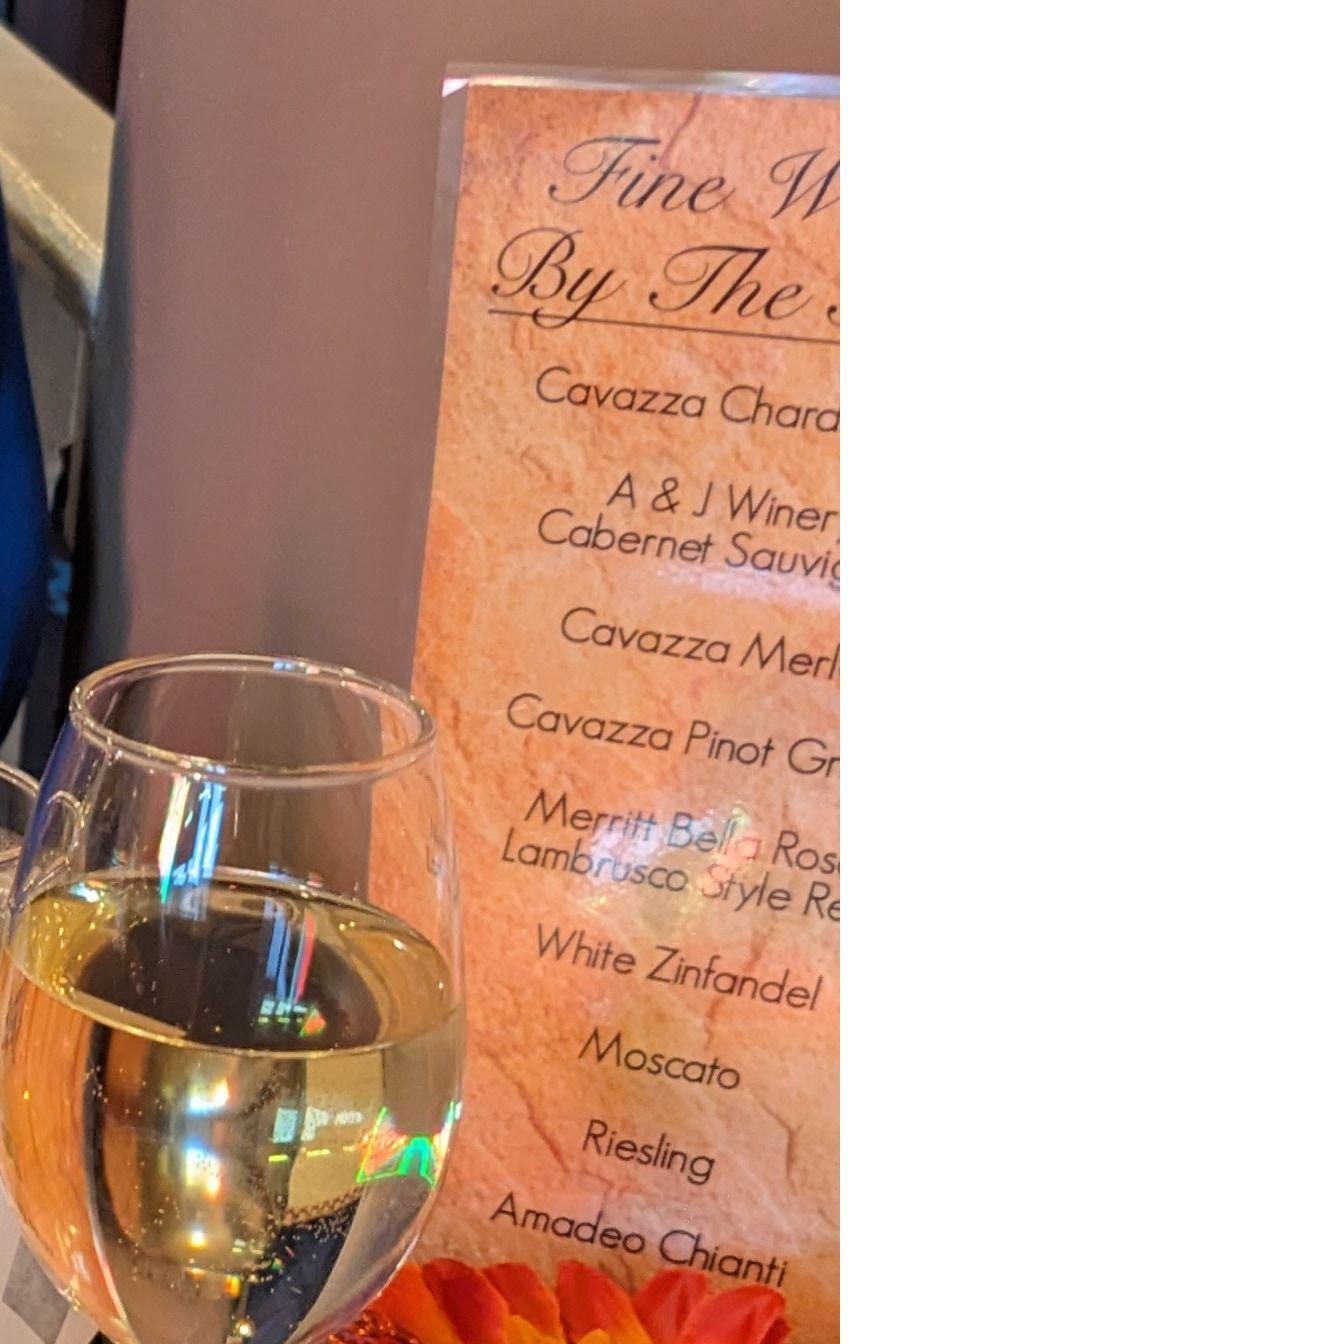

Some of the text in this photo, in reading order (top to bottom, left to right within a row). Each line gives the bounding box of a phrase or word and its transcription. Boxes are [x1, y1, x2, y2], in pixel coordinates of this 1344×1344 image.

[549, 136, 734, 208] Fine
[491, 227, 814, 329] By The
[536, 366, 707, 419] Cavazza
[538, 508, 713, 563] Cabernet
[606, 473, 840, 544] A & J Winer
[561, 606, 840, 680] Cavazza Merl
[507, 692, 674, 751] Cavazza
[685, 719, 775, 767] Pinot
[524, 788, 657, 842] Merritt
[772, 829, 840, 875] Ros
[502, 828, 689, 892] Lambrusco
[700, 862, 792, 912] Style
[537, 922, 824, 1011] White Zinfandel
[579, 1026, 741, 1090] Moscato
[583, 1119, 715, 1185] Riesling
[491, 1192, 787, 1287] Amadeo Chianti
